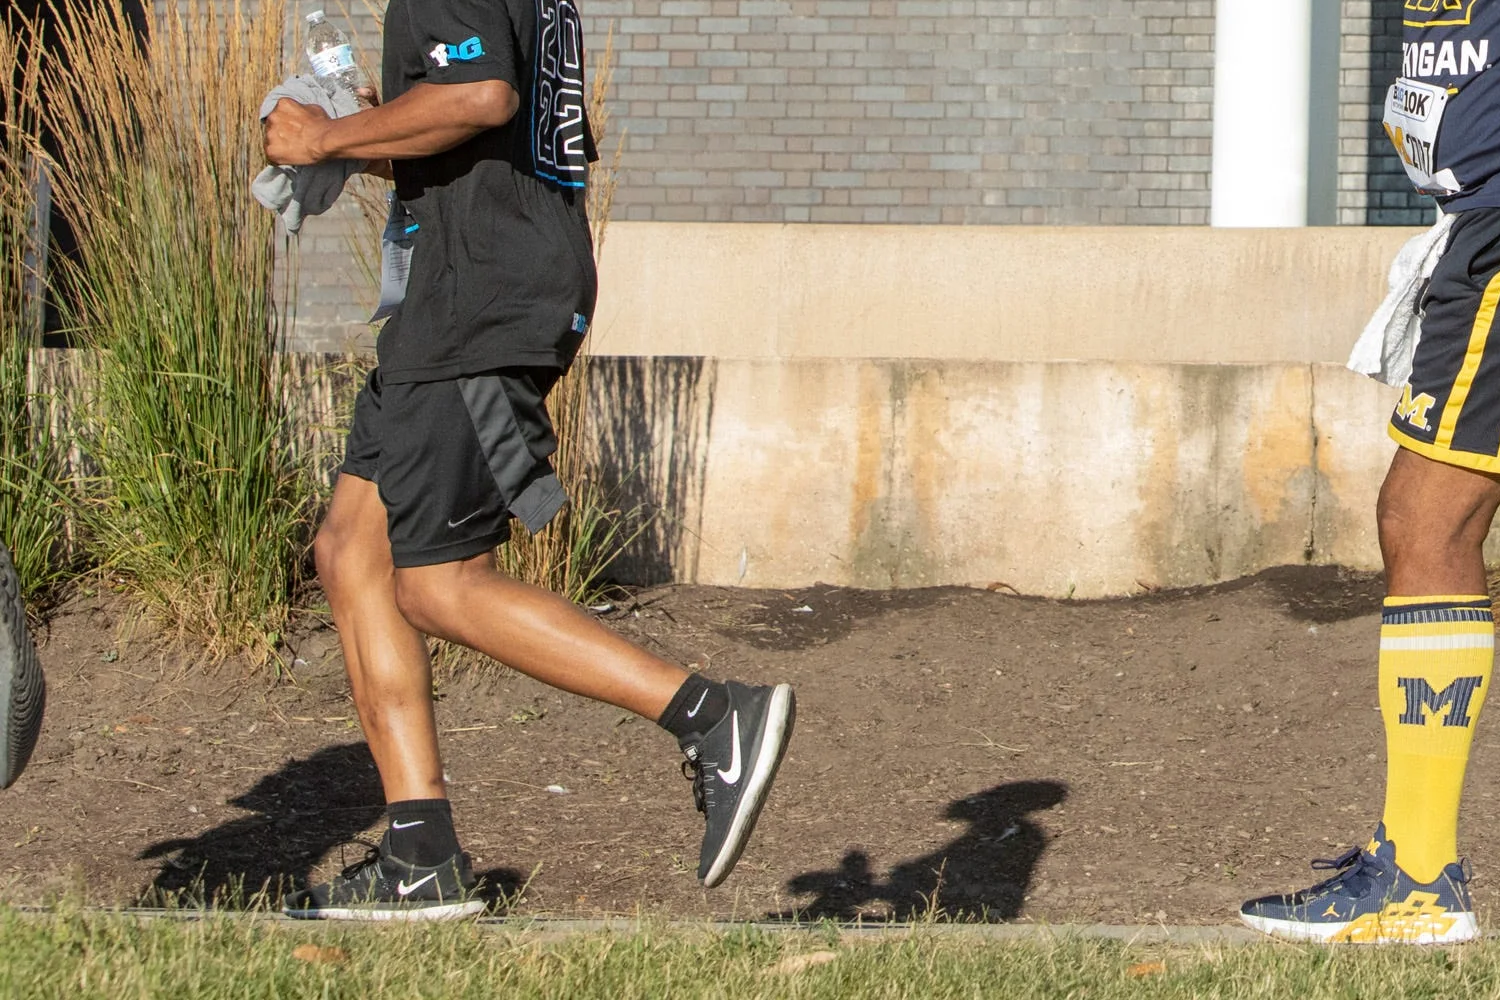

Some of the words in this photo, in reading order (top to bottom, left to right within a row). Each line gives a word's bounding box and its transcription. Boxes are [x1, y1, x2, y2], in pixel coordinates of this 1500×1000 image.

[1404, 90, 1430, 117] 10K
[1396, 382, 1436, 430] M
[1397, 676, 1483, 728] M
